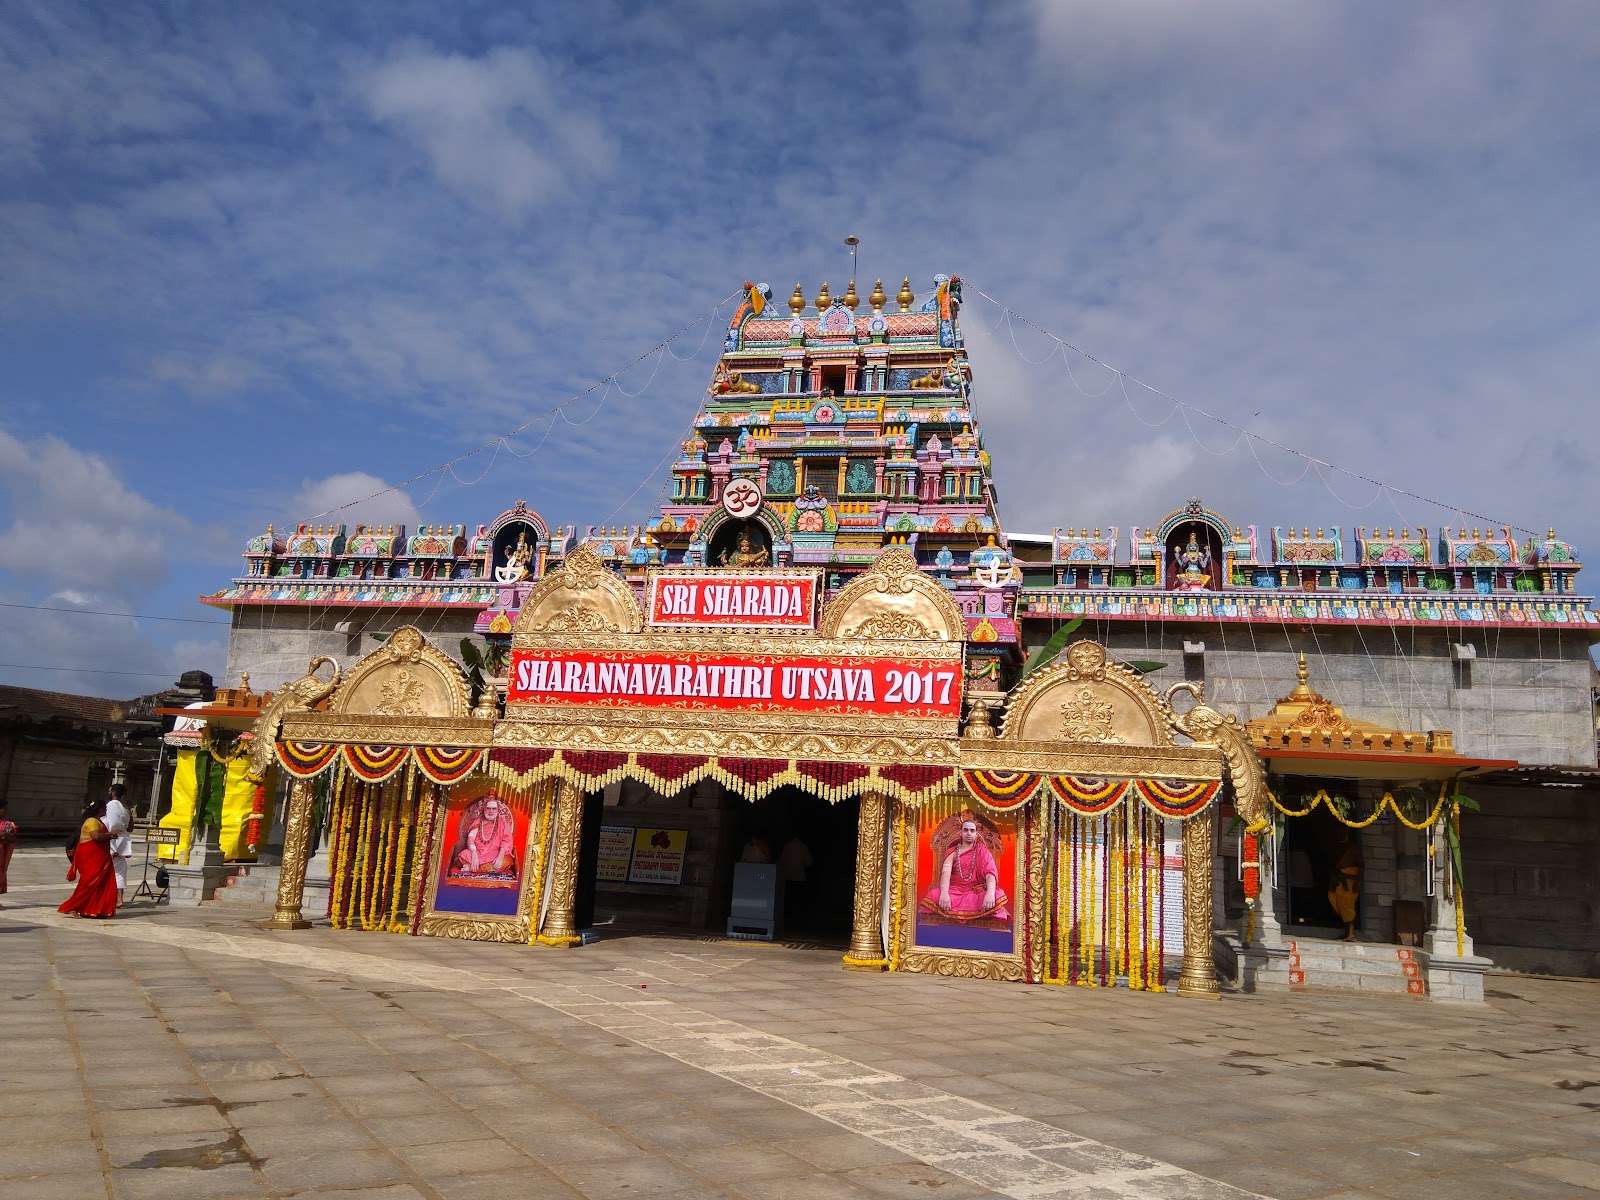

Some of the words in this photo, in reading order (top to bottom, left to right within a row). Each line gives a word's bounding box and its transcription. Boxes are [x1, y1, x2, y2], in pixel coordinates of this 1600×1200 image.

[662, 585, 698, 615] SRI
[703, 585, 802, 617] SHARADA
[517, 659, 774, 698] SHARANNAVARATHRI
[782, 667, 875, 701] UTSAVA
[884, 671, 954, 704] 2017
